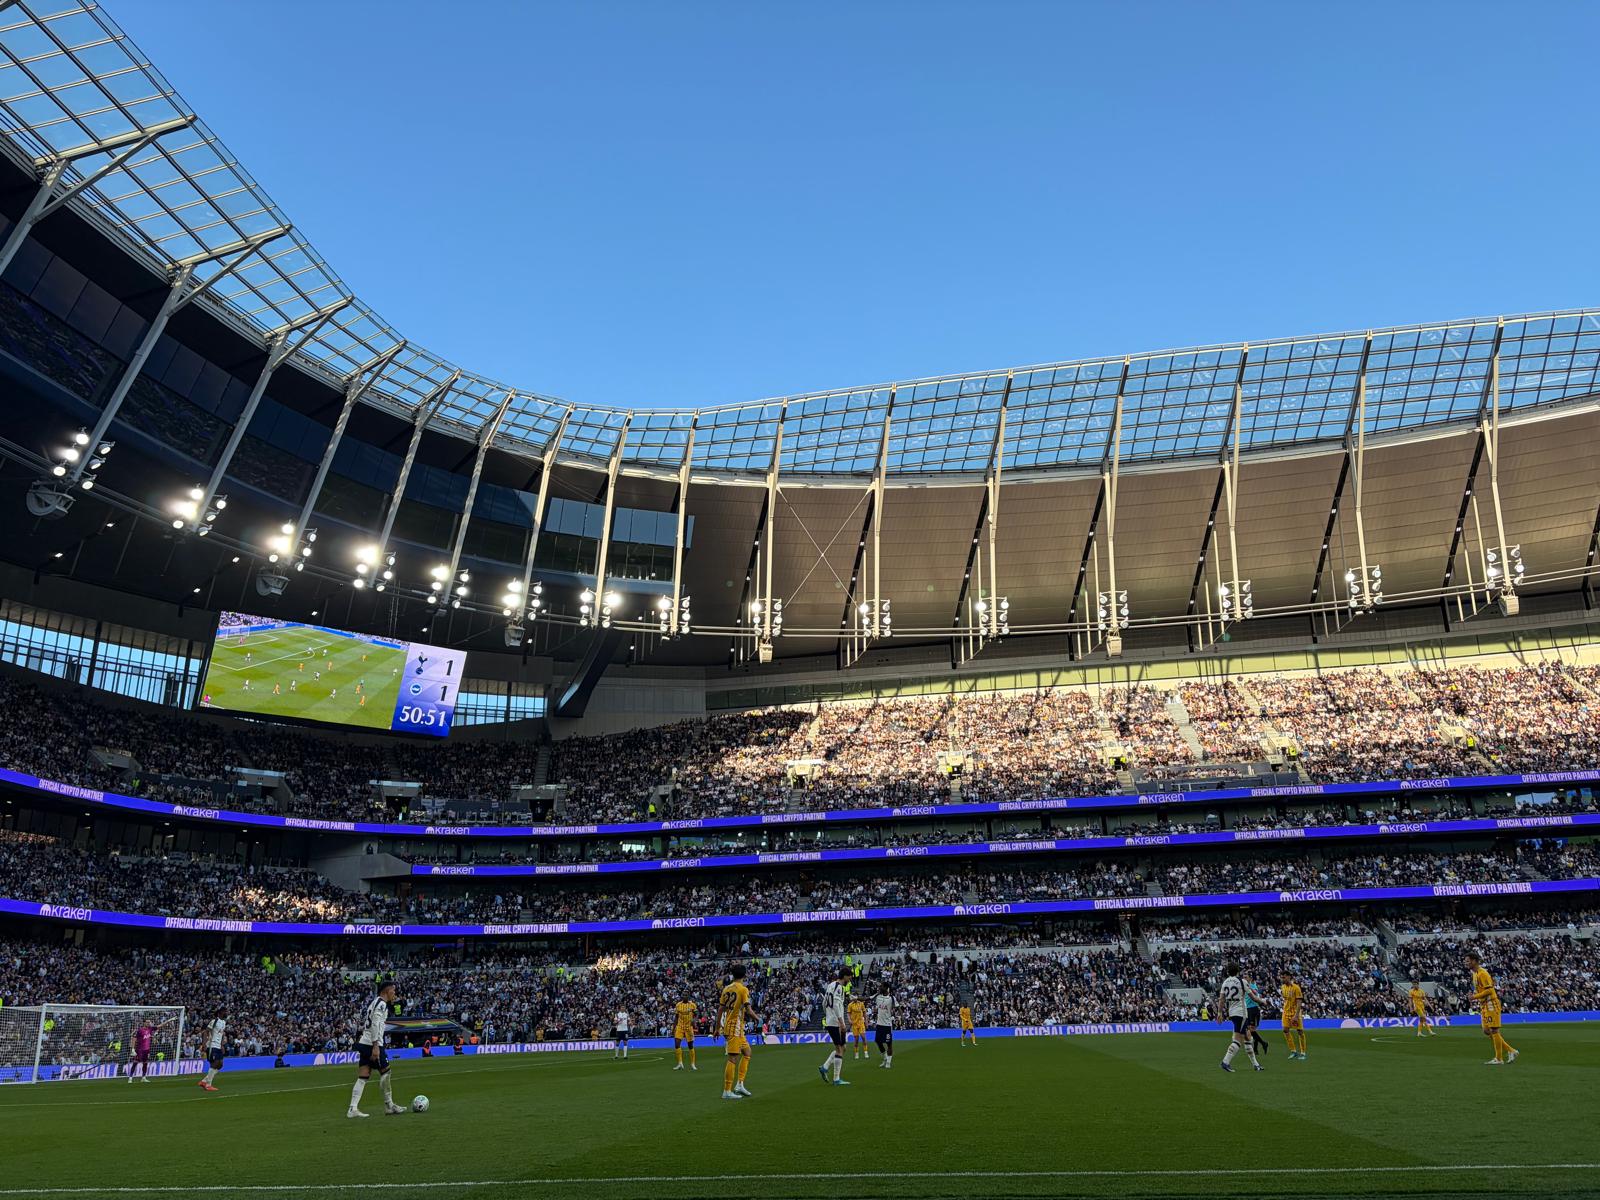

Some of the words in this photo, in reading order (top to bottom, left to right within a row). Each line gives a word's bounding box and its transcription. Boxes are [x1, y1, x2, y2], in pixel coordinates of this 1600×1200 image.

[446, 660, 453, 677] 1
[440, 685, 447, 702] 1
[399, 705, 446, 727] 50:51
[1522, 773, 1548, 783] OFFICIAL
[1549, 772, 1572, 782] CRYPTO
[1573, 770, 1600, 780] PARTNER
[39, 778, 59, 792] OFFICIAL
[60, 784, 79, 797] CRYPTO
[80, 788, 103, 802] PARTNER
[1252, 787, 1275, 797] OFFICIAL
[1276, 786, 1297, 795] CRYPTO
[1298, 785, 1324, 795] PARTNER
[999, 800, 1021, 811] OFFICIAL
[1022, 800, 1042, 810] CRYPTO
[1043, 798, 1067, 809] PARTNER
[286, 817, 307, 828] OFFICIAL
[309, 819, 330, 829] CRYPTO
[331, 821, 354, 831] PARTNER
[762, 814, 783, 824] OFFICIAL
[784, 813, 803, 822] CRYPTO
[804, 811, 825, 820] PARTNER
[1497, 818, 1521, 828] OFFICIAL
[1522, 817, 1545, 827] CRYPTO
[1546, 816, 1572, 825] PARTNER
[533, 826, 554, 835] OFFICIAL
[555, 826, 574, 834] CRYPTO
[575, 825, 597, 834] PARTNER
[1235, 831, 1257, 840] OFFICIAL
[1258, 830, 1279, 839] CRYPTO
[1280, 828, 1305, 837] PARTNER
[990, 843, 1011, 852] OFFICIAL
[1012, 842, 1032, 851] CRYPTO
[1033, 840, 1056, 850] PARTNER
[759, 853, 779, 863] OFFICIAL
[780, 853, 798, 862] CRYPTO
[799, 851, 821, 861] PARTNER
[536, 865, 556, 874] OFFICIAL
[557, 865, 576, 873] CRYPTO
[577, 864, 598, 873] PARTNER
[1433, 885, 1466, 896] OFFICIAL
[1467, 883, 1496, 895] CRYPTO
[1497, 882, 1532, 894] PARTNER
[1094, 899, 1124, 909] OFFICIAL
[1125, 899, 1152, 908] CRYPTO
[1153, 896, 1184, 907] PARTNER
[783, 912, 810, 923] OFFICIAL
[811, 911, 835, 921] CRYPTO
[837, 909, 865, 920] PARTNER
[165, 917, 193, 929] OFFICIAL
[195, 919, 220, 931] CRYPTO
[221, 921, 252, 932] PARTNER
[484, 925, 512, 934] OFFICIAL
[513, 925, 538, 934] CRYPTO
[539, 923, 568, 933] PARTNER
[1224, 986, 1239, 1001] 22
